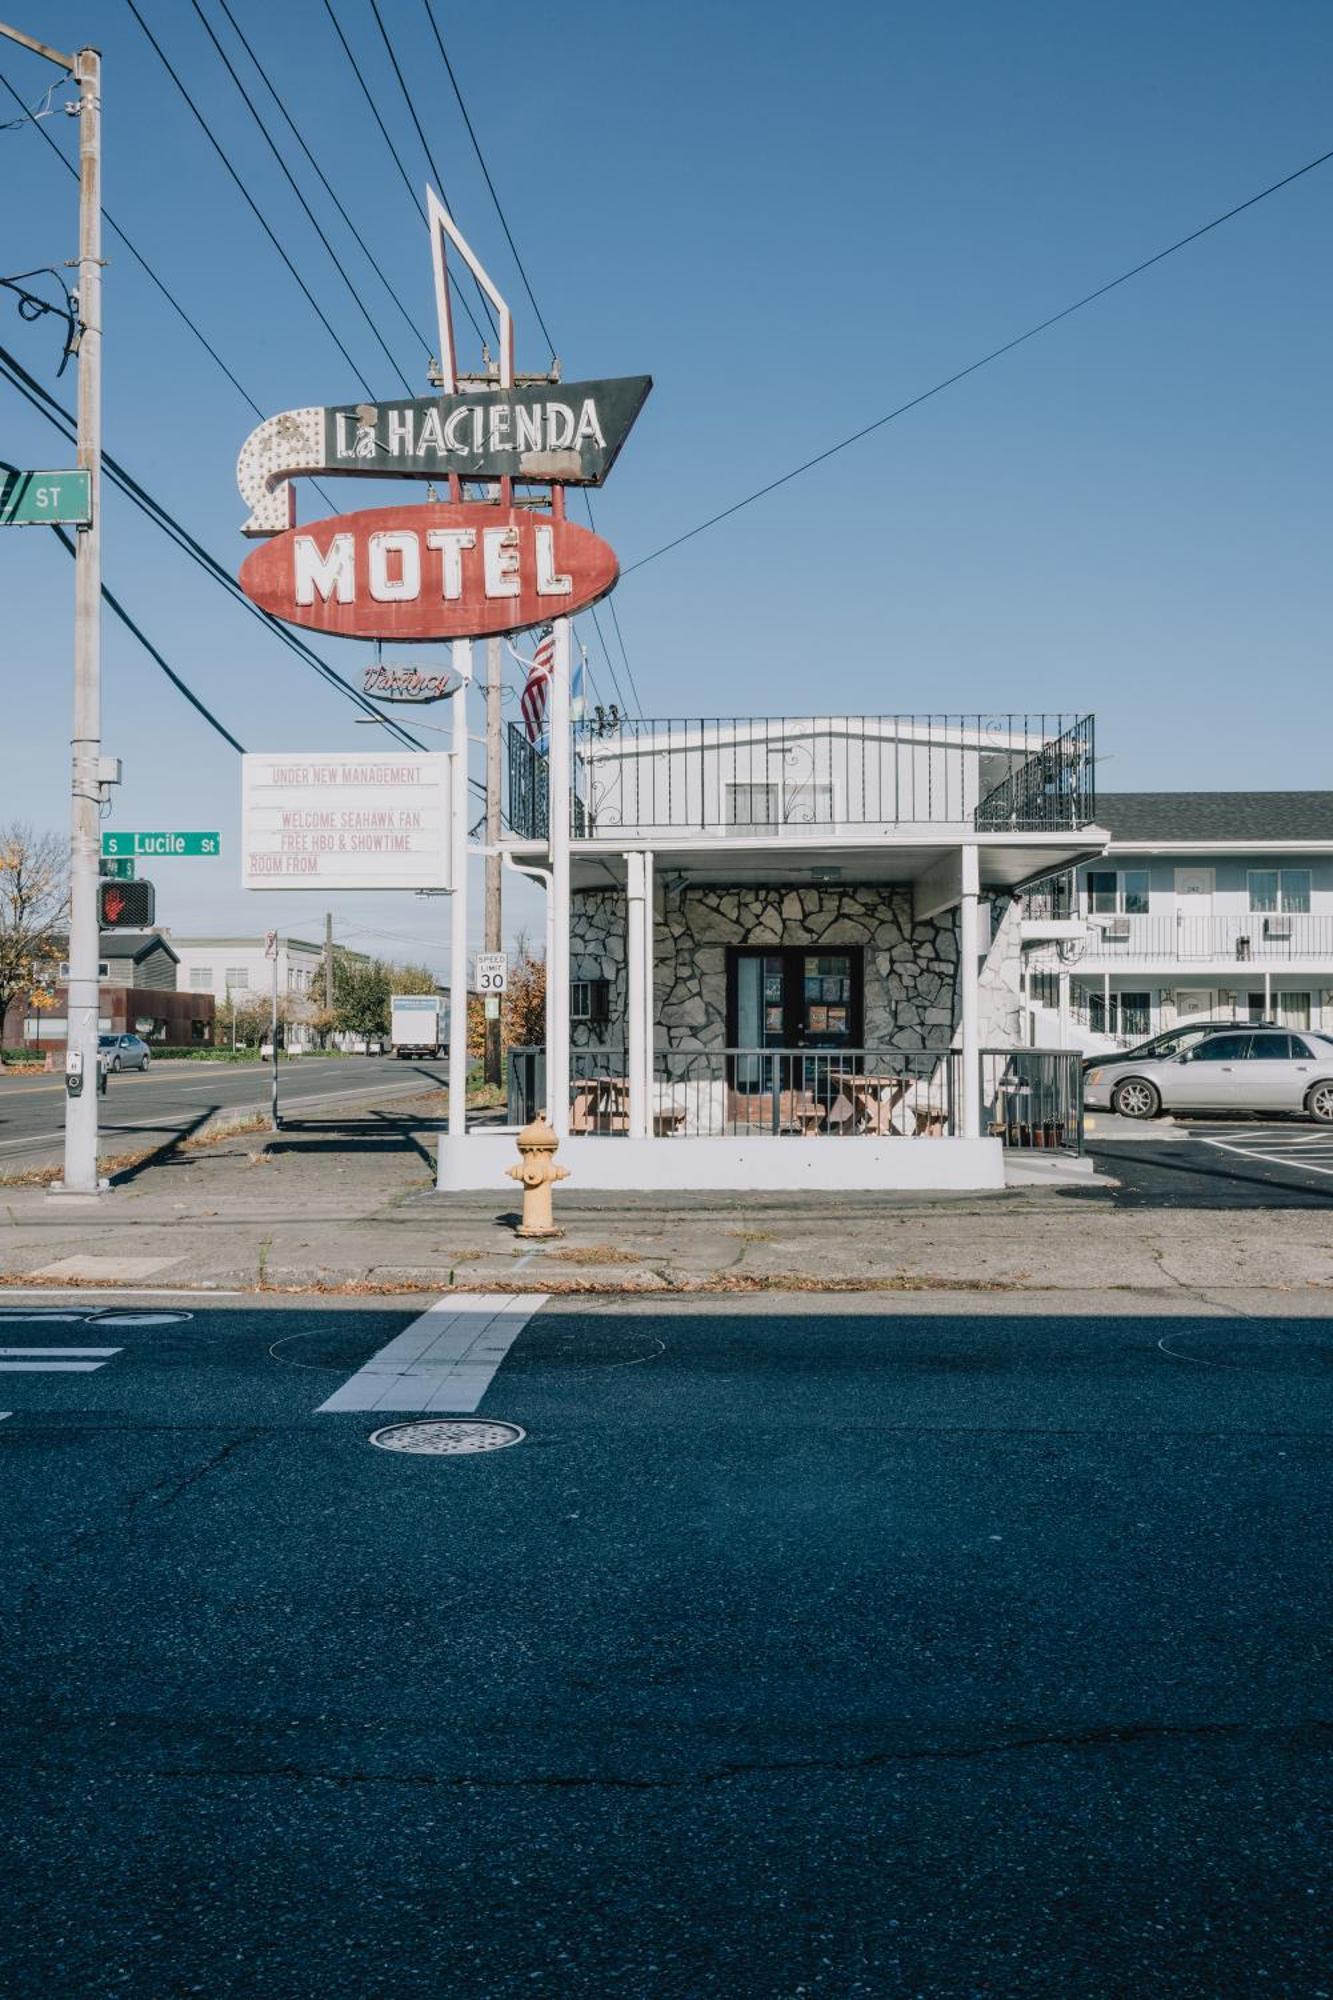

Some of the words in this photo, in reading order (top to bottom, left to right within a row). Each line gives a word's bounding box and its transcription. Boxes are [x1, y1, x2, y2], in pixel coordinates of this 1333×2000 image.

[336, 412, 376, 458] La
[388, 398, 607, 457] HACIENDA
[35, 487, 61, 508] ST
[293, 525, 572, 607] MOTEL
[363, 665, 449, 696] Vacancy
[272, 767, 309, 784] UNDER
[313, 767, 337, 784] NEW
[342, 767, 421, 784] MANAGEMENT
[282, 812, 336, 829] WELCOME
[341, 812, 394, 828] SEAHAWK
[400, 811, 420, 828] FAN
[108, 838, 118, 853] S
[134, 833, 185, 853] Lucile
[201, 838, 215, 853] St
[281, 834, 309, 851] FREE
[312, 834, 334, 850] HBO
[339, 834, 346, 850] &
[351, 834, 411, 850] SHOWTIME
[250, 856, 281, 873] ROOM
[286, 856, 317, 873] FROM
[479, 956, 504, 964] SPEED
[480, 964, 502, 972] LIMIT
[481, 974, 504, 989] 30
